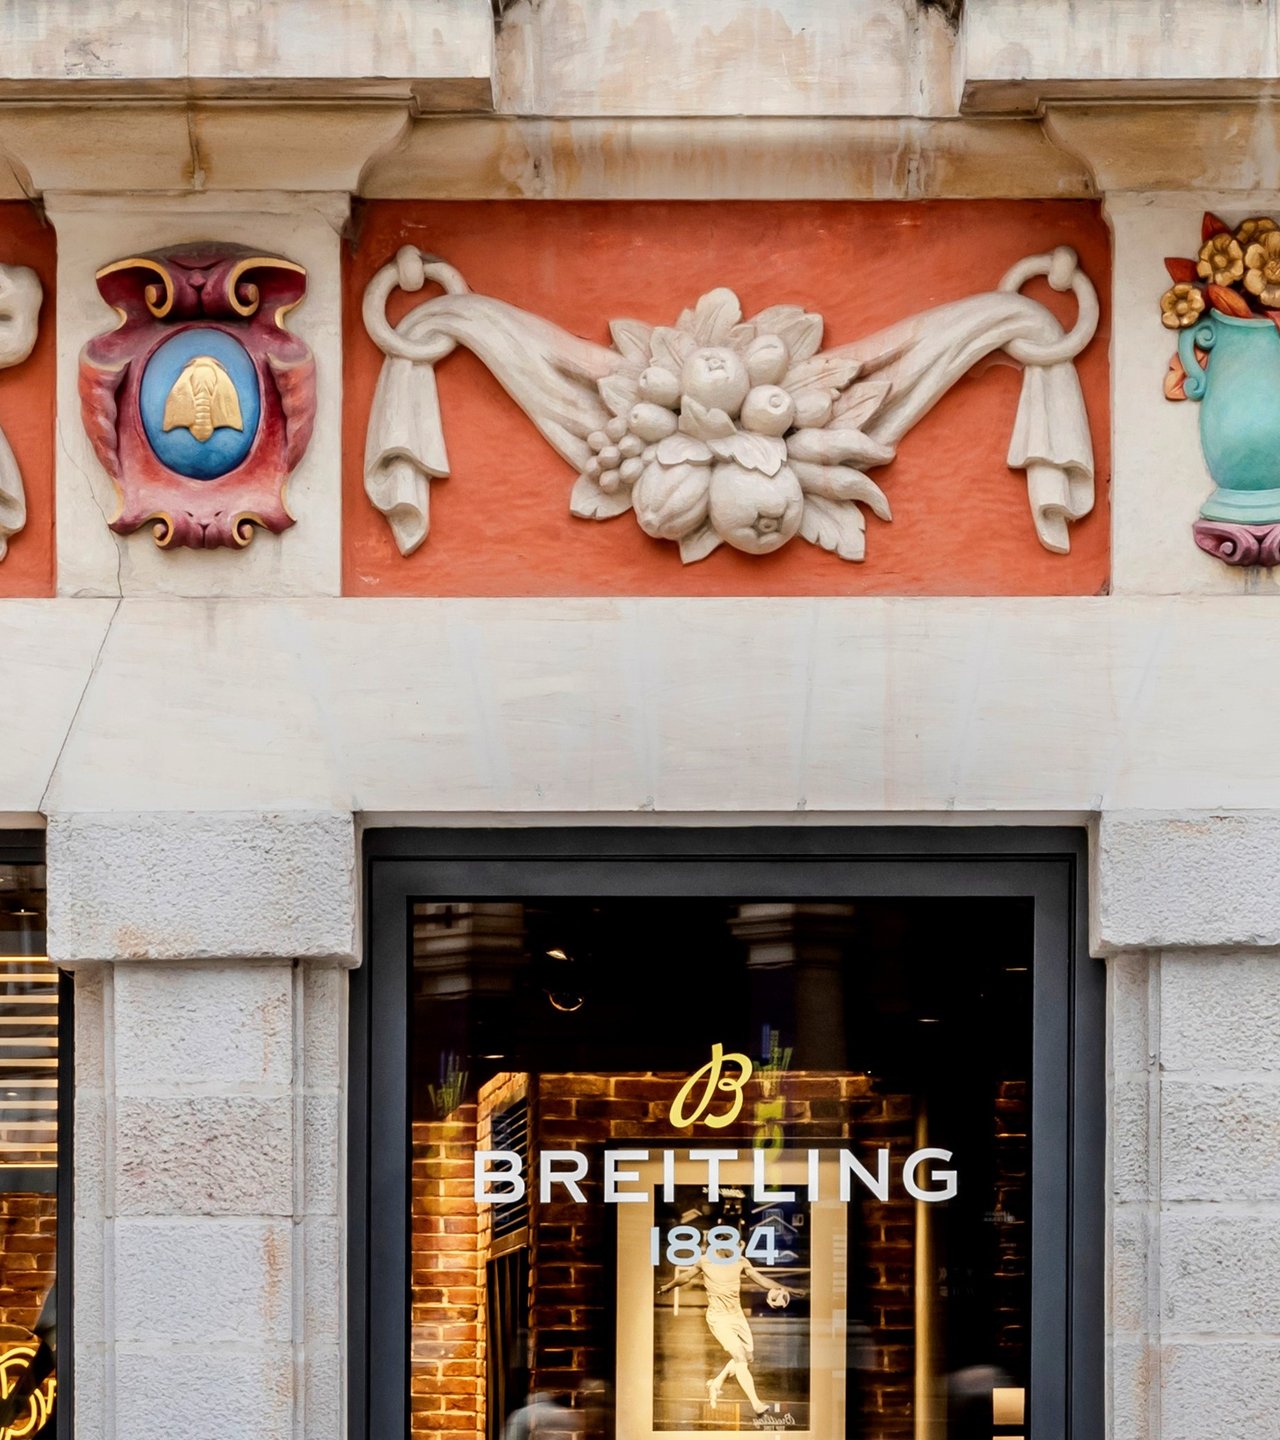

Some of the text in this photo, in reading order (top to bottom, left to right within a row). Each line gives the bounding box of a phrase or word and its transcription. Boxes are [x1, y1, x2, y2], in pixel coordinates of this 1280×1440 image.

[669, 1043, 753, 1128] B
[474, 1148, 958, 1204] BREITLING
[650, 1225, 780, 1266] 1884
